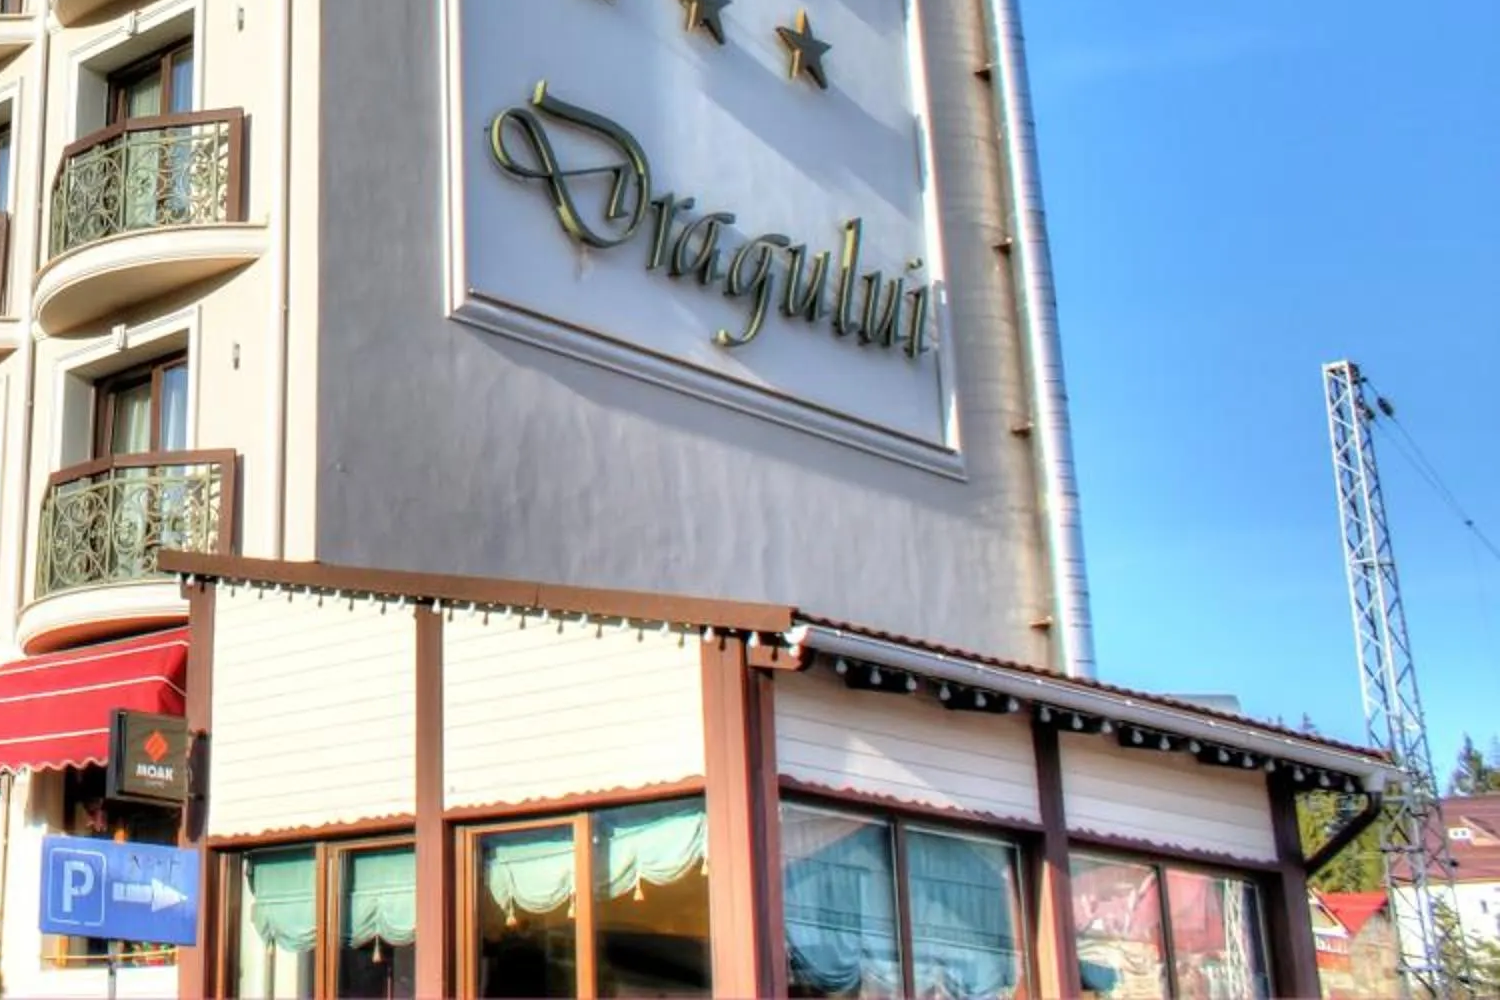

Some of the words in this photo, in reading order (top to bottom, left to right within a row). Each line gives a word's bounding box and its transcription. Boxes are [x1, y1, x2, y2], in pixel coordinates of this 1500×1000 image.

[490, 79, 930, 359] Dragului
[136, 763, 173, 781] MOAK
[62, 860, 95, 913] P
